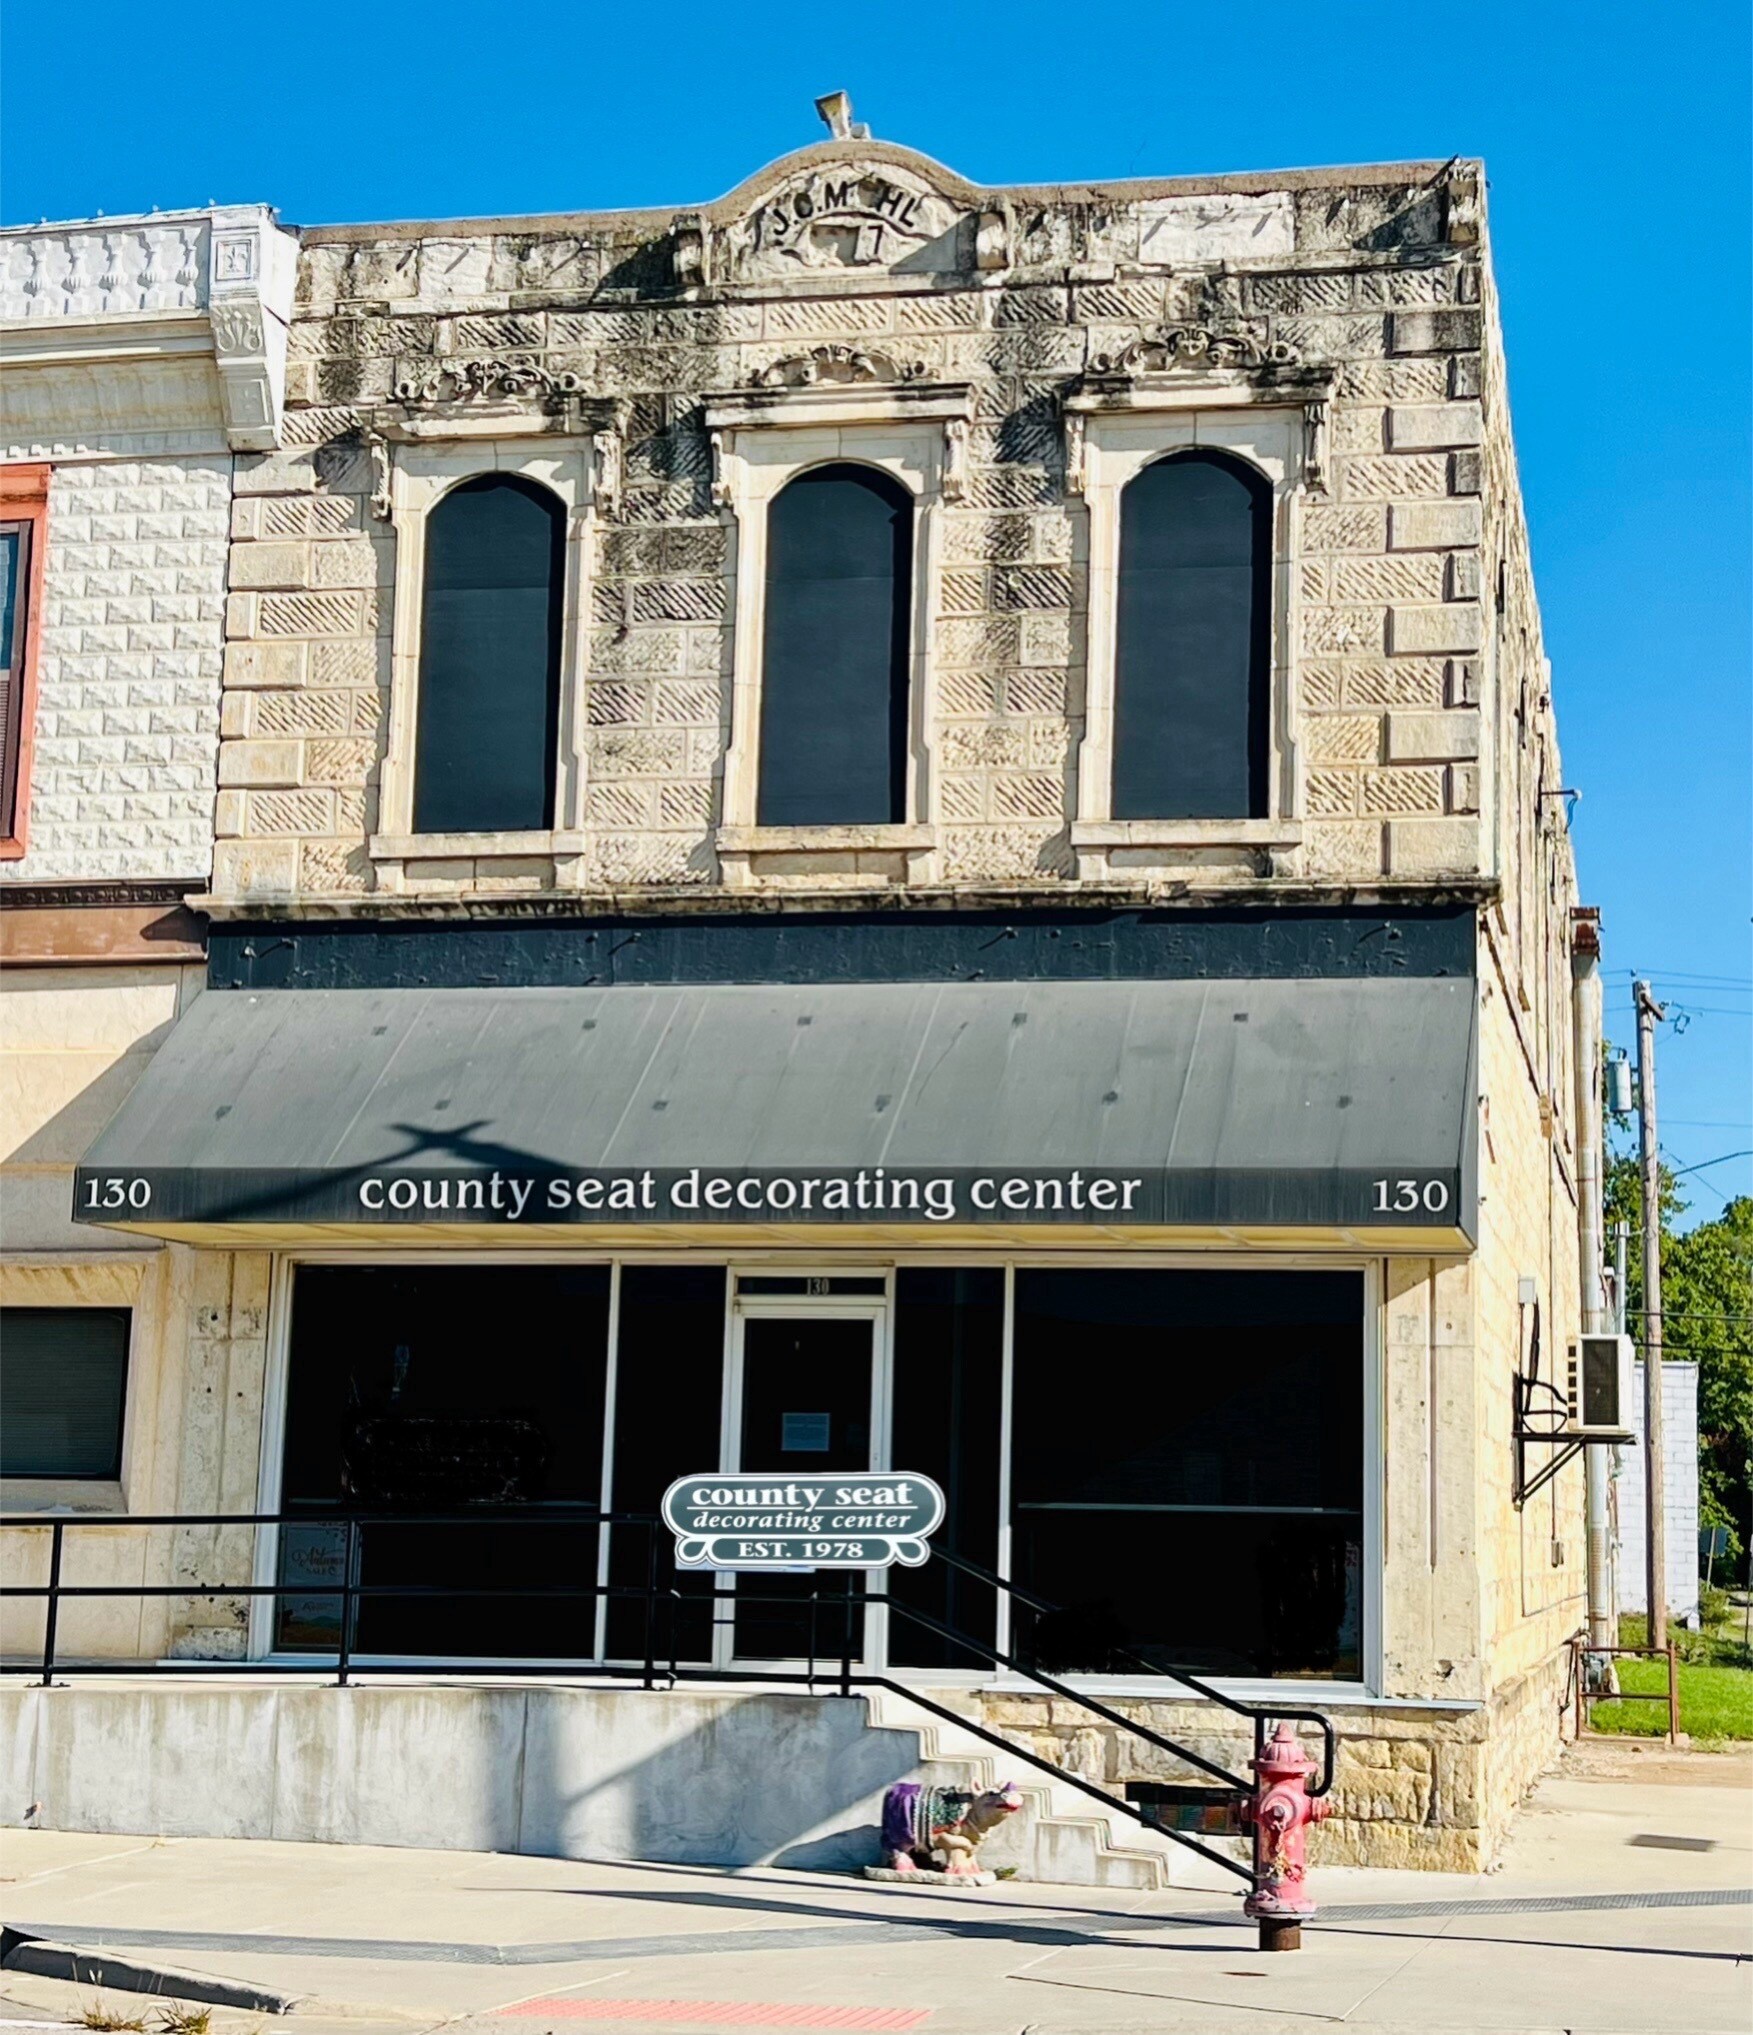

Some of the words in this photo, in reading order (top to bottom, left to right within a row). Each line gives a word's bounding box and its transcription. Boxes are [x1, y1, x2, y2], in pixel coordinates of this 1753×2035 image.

[84, 1178, 152, 1209] 130
[358, 1172, 535, 1219] county
[546, 1171, 657, 1209] seat
[669, 1168, 956, 1221] decorating
[969, 1170, 1142, 1210] center
[1372, 1179, 1449, 1212] 130
[807, 1278, 830, 1296] 130
[691, 1483, 826, 1512] county
[834, 1482, 913, 1506] seat
[692, 1510, 825, 1533] decorating
[831, 1512, 912, 1529] center
[737, 1541, 792, 1558] EST.
[801, 1541, 864, 1558] 1978
